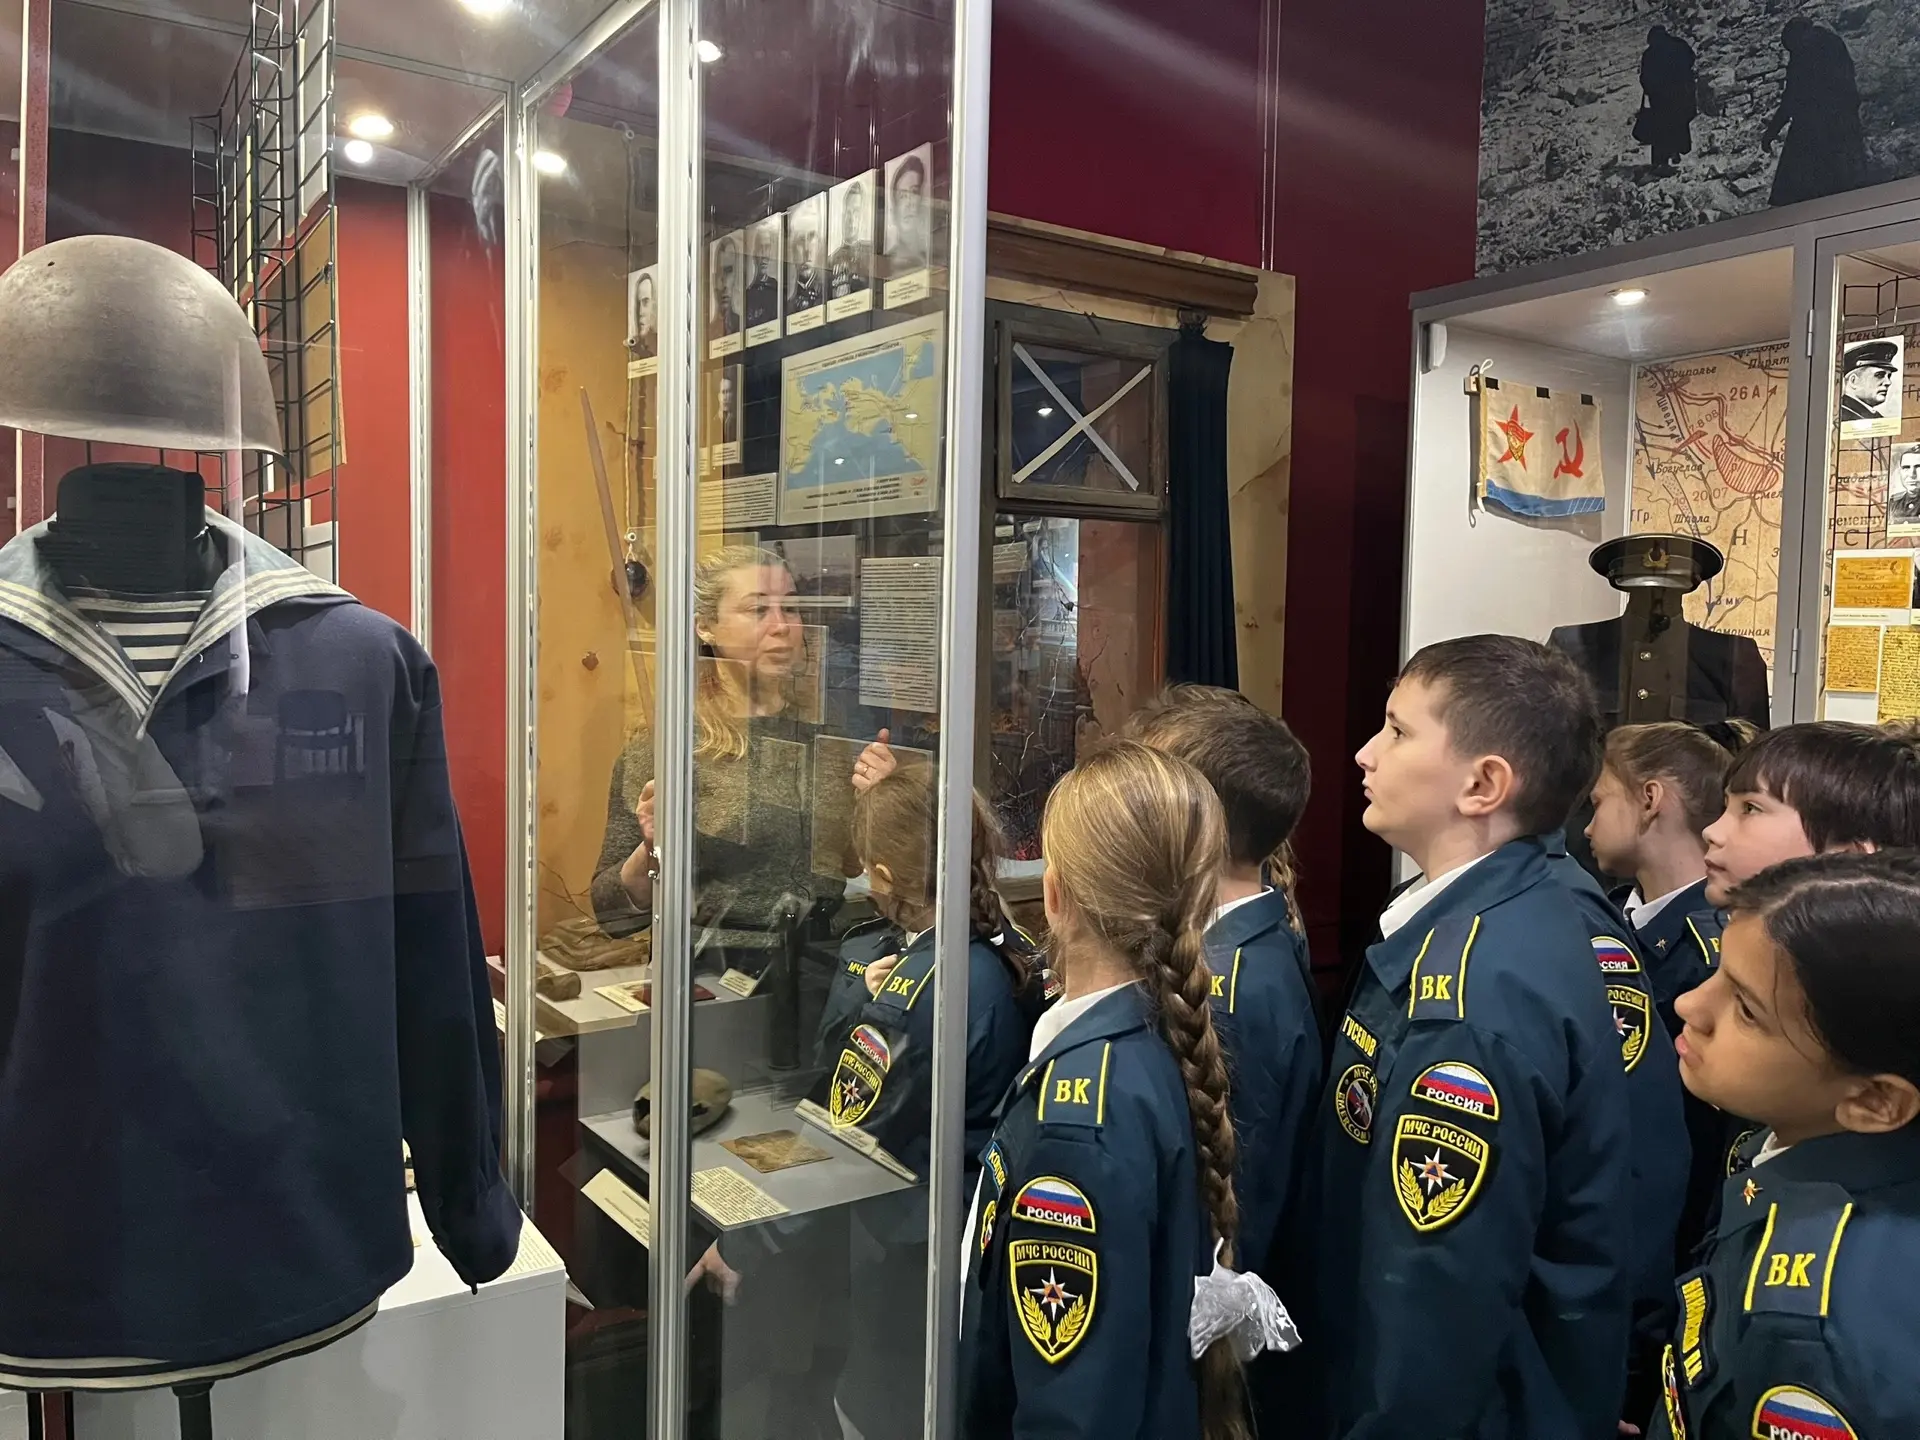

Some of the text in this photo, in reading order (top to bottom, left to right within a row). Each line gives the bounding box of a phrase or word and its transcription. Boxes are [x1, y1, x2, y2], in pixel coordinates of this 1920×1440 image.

[1729, 384, 1761, 400] 26 А
[1692, 490, 1708, 502] 20
[1731, 529, 1748, 546] Н
[1599, 961, 1629, 970] ССИЯ
[886, 976, 915, 996] ВК
[1210, 975, 1226, 997] К
[1418, 975, 1453, 1000] ВК
[856, 1037, 884, 1066] РОССИЯ
[842, 1053, 879, 1090] МЧС РОССИИ
[1053, 1078, 1091, 1105] ВК
[1426, 1087, 1485, 1114] РОССИЯ
[1402, 1119, 1482, 1159] МЧС РОССИИ
[1026, 1205, 1083, 1228] РОССИЯ
[1015, 1244, 1091, 1270] МЧС РОССИИ
[1764, 1252, 1816, 1288] ВК
